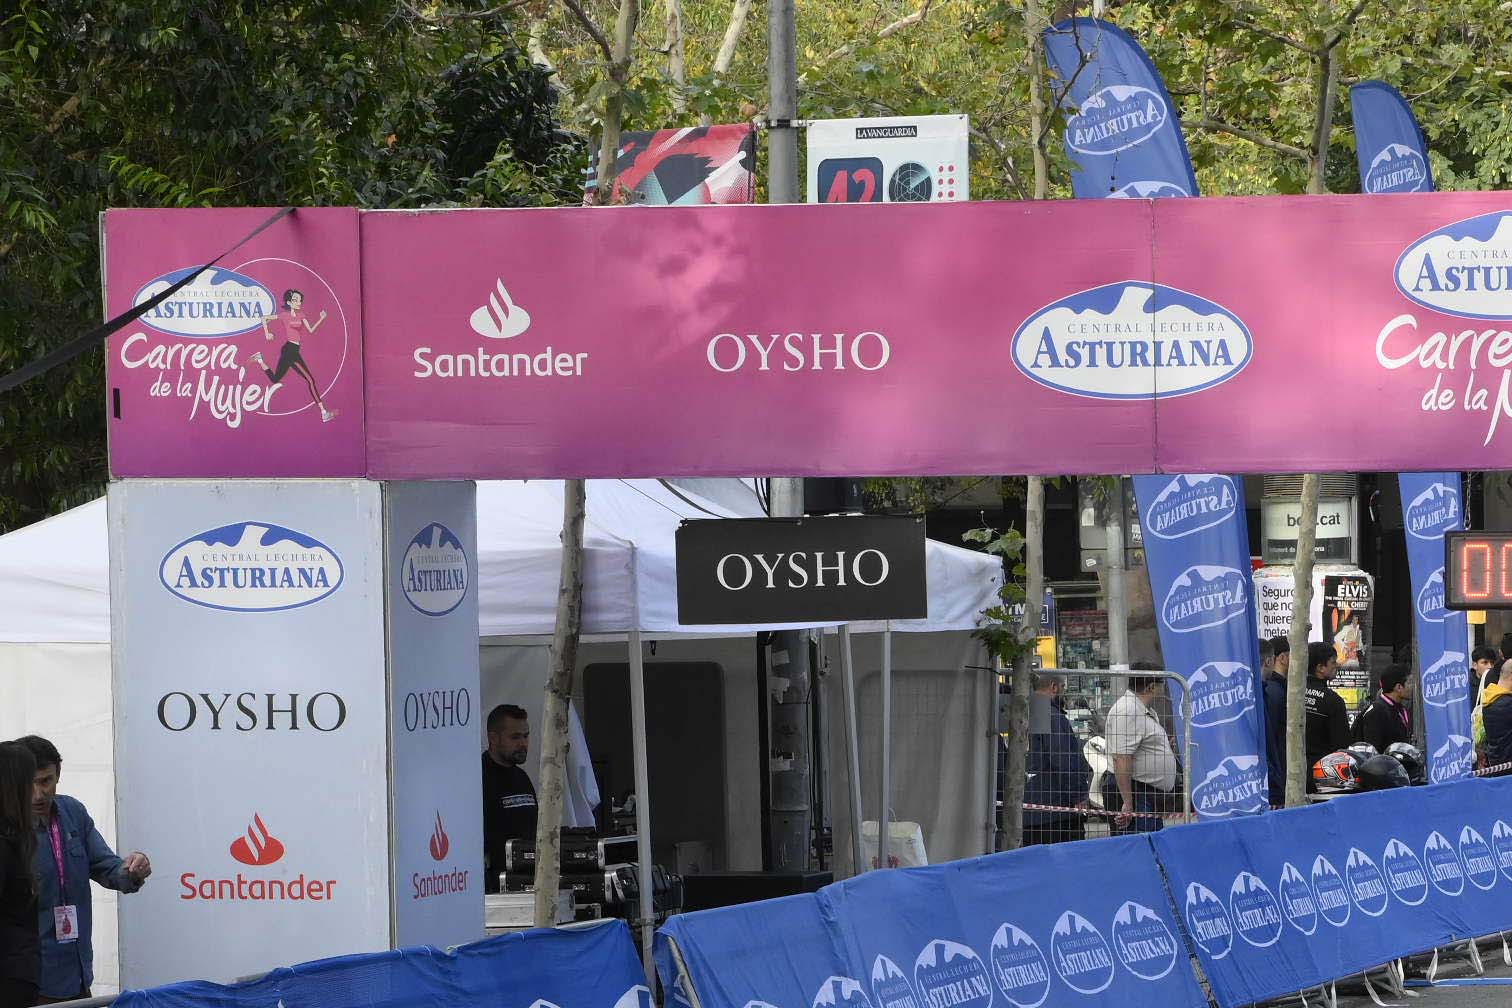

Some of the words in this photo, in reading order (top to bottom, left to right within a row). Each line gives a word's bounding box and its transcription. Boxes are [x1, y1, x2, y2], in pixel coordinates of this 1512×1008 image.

[857, 129, 867, 138] LA
[867, 126, 916, 137] VANGUARDIA
[170, 289, 209, 298] ENTRAL
[1067, 323, 1142, 334] CENTRAL
[1150, 321, 1225, 333] LECHERA
[120, 332, 238, 370] Carrera
[414, 347, 588, 377] Santander
[707, 331, 891, 372] OYSHO
[1031, 326, 1234, 368] ASTURIANA
[150, 372, 171, 397] de
[176, 372, 192, 397] la
[190, 367, 283, 428] Mujer
[1421, 373, 1456, 412] de
[1464, 370, 1488, 411] la
[174, 555, 331, 588] ASTURIANA
[202, 553, 261, 562] CENTRAL
[266, 553, 324, 562] LECHERA
[717, 549, 889, 591] OYSHO
[406, 557, 464, 593] ASTURIANA
[1337, 585, 1368, 598] ELVIS
[1263, 602, 1279, 613] que
[157, 692, 346, 731] OYSHO
[404, 687, 470, 732] OYSHO
[180, 873, 336, 900] Santander
[413, 867, 469, 899] Santander
[996, 957, 1047, 991] ASTURIANA
[1056, 944, 1111, 977] ASTURIANA
